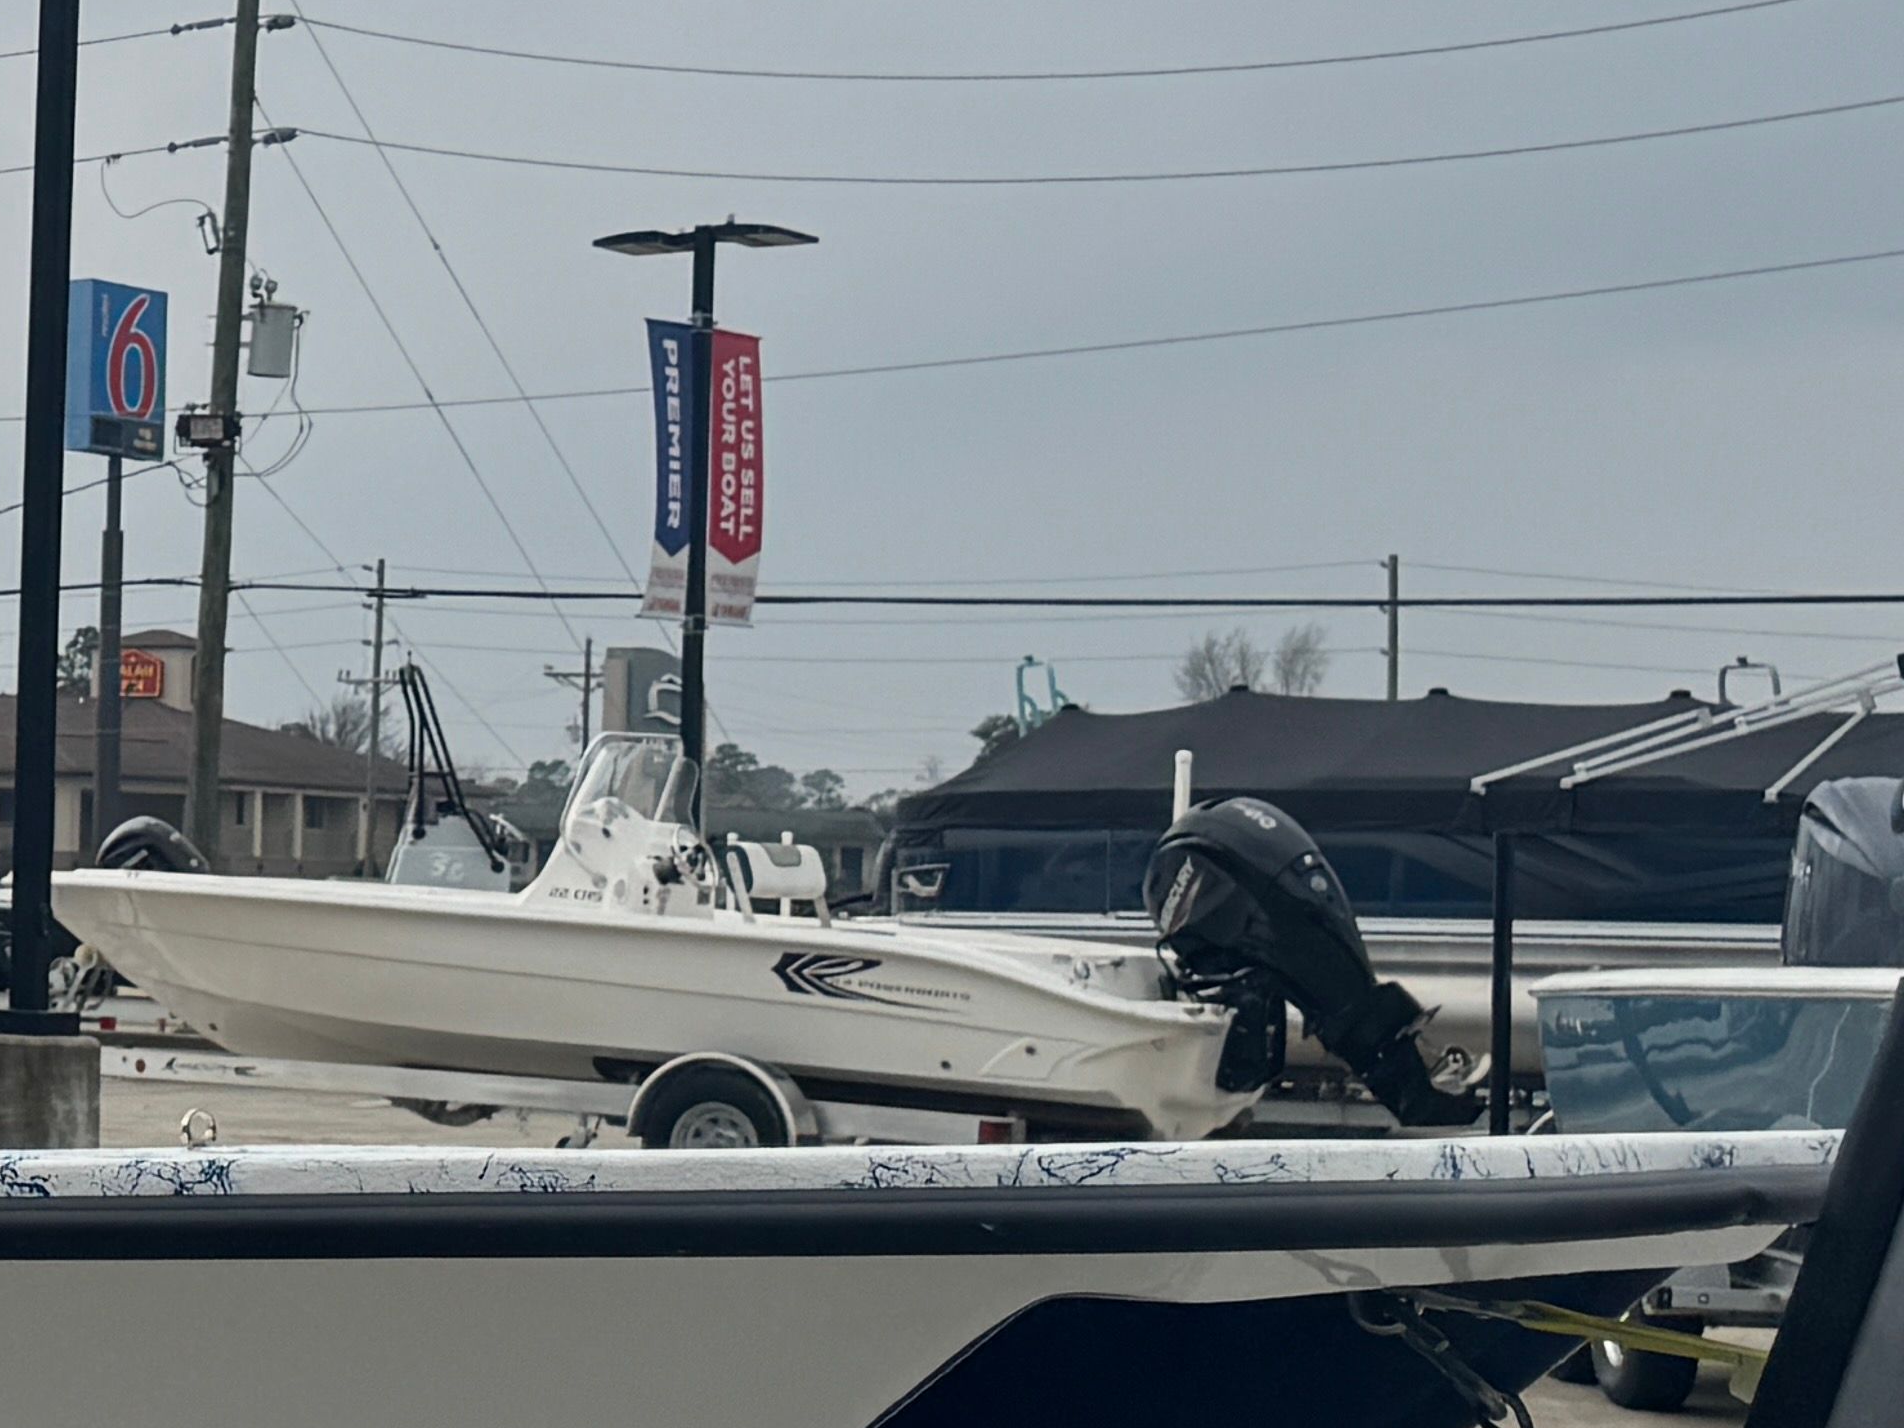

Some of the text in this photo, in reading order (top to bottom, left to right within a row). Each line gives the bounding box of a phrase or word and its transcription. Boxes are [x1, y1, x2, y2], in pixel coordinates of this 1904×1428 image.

[106, 293, 158, 421] 6
[662, 338, 682, 529] PREMIER
[719, 358, 736, 536] YOUR BOAT
[738, 355, 755, 542] LET US SELL
